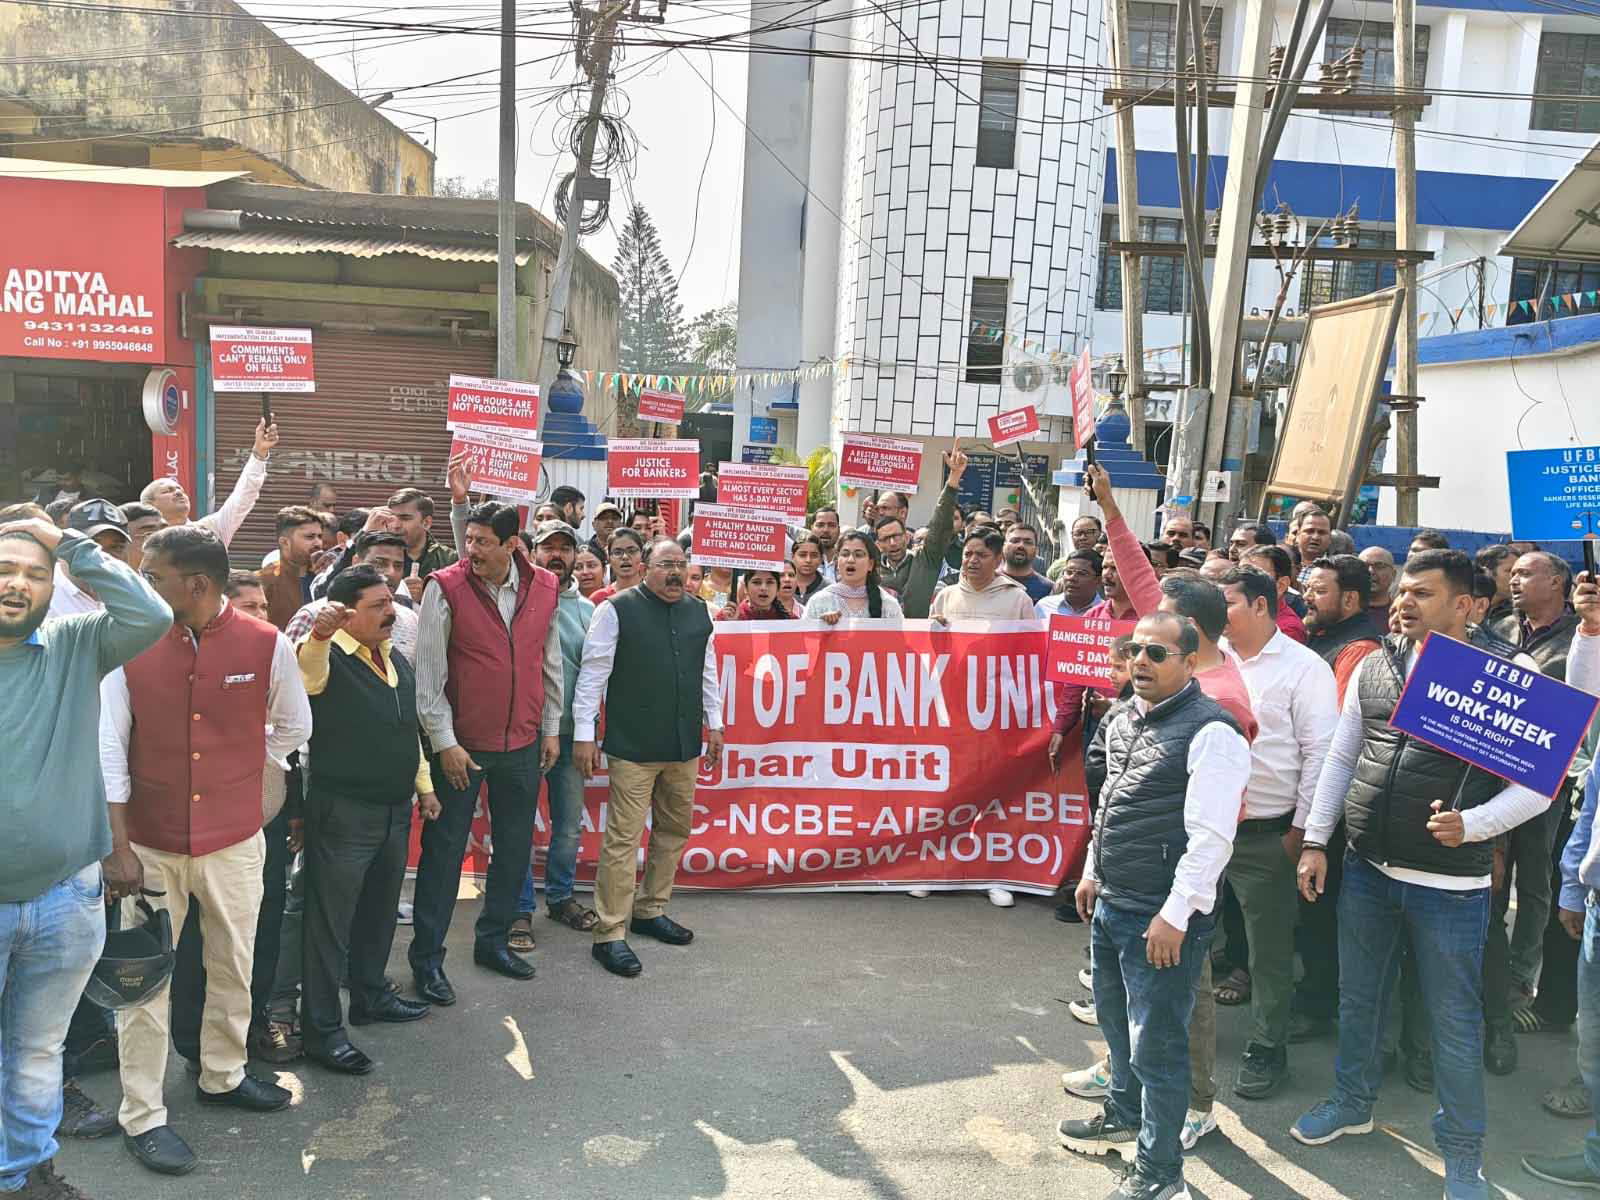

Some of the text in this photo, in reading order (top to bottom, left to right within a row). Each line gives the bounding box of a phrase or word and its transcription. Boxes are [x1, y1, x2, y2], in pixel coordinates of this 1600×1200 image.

[4, 268, 109, 294] ADITYA
[0, 291, 153, 317] NG MAHAL
[24, 320, 153, 335] 9431132448
[24, 337, 45, 347] Call
[47, 338, 62, 347] No
[71, 340, 89, 349] +91
[231, 345, 295, 355] COMMITMENTS
[219, 354, 307, 365] CAN'T REMAIN ONLY
[245, 363, 283, 373] ON FILES
[456, 393, 532, 409] LONG HOURS ARE
[452, 401, 535, 418] NOT PRODUCTIVITY
[463, 444, 528, 463] 5-DAY BANKING
[856, 450, 879, 459] RESTED
[880, 453, 906, 461] BANKER
[1563, 449, 1600, 462] UFB
[471, 455, 479, 464] IS
[480, 457, 487, 465] A
[488, 459, 513, 470] RIGHT
[635, 458, 671, 467] JUSTICE
[853, 457, 871, 465] MORE
[872, 459, 914, 470] RESPONSIBLE
[480, 466, 486, 474] A
[488, 467, 529, 481] PRIVILEGE
[622, 468, 687, 478] FOR BANKERS
[867, 465, 893, 474] BANKER
[1569, 475, 1600, 483] BAN
[722, 484, 803, 496] ALMOST EVERY SECTOR
[732, 494, 791, 504] HAS 5-DAY WEEK
[712, 521, 745, 530] HEALTHY
[746, 525, 775, 533] BANKER
[710, 530, 769, 541] SERVES SOCIETY
[702, 538, 776, 552] BETTER AND LONGER
[1084, 619, 1111, 631] UFBU
[1052, 631, 1095, 645] BANKERS
[1077, 651, 1110, 664] 5 DAY
[1485, 659, 1534, 689] UFBU
[752, 653, 809, 728] OF
[823, 651, 951, 727] BANK
[1471, 679, 1527, 711] 5 DAY
[1427, 682, 1557, 750] WORK-WEEK
[1450, 714, 1515, 748] IS OUR RIGHT
[831, 748, 942, 781] Unit
[680, 832, 1063, 875] OC-NOBW-NOBO)
